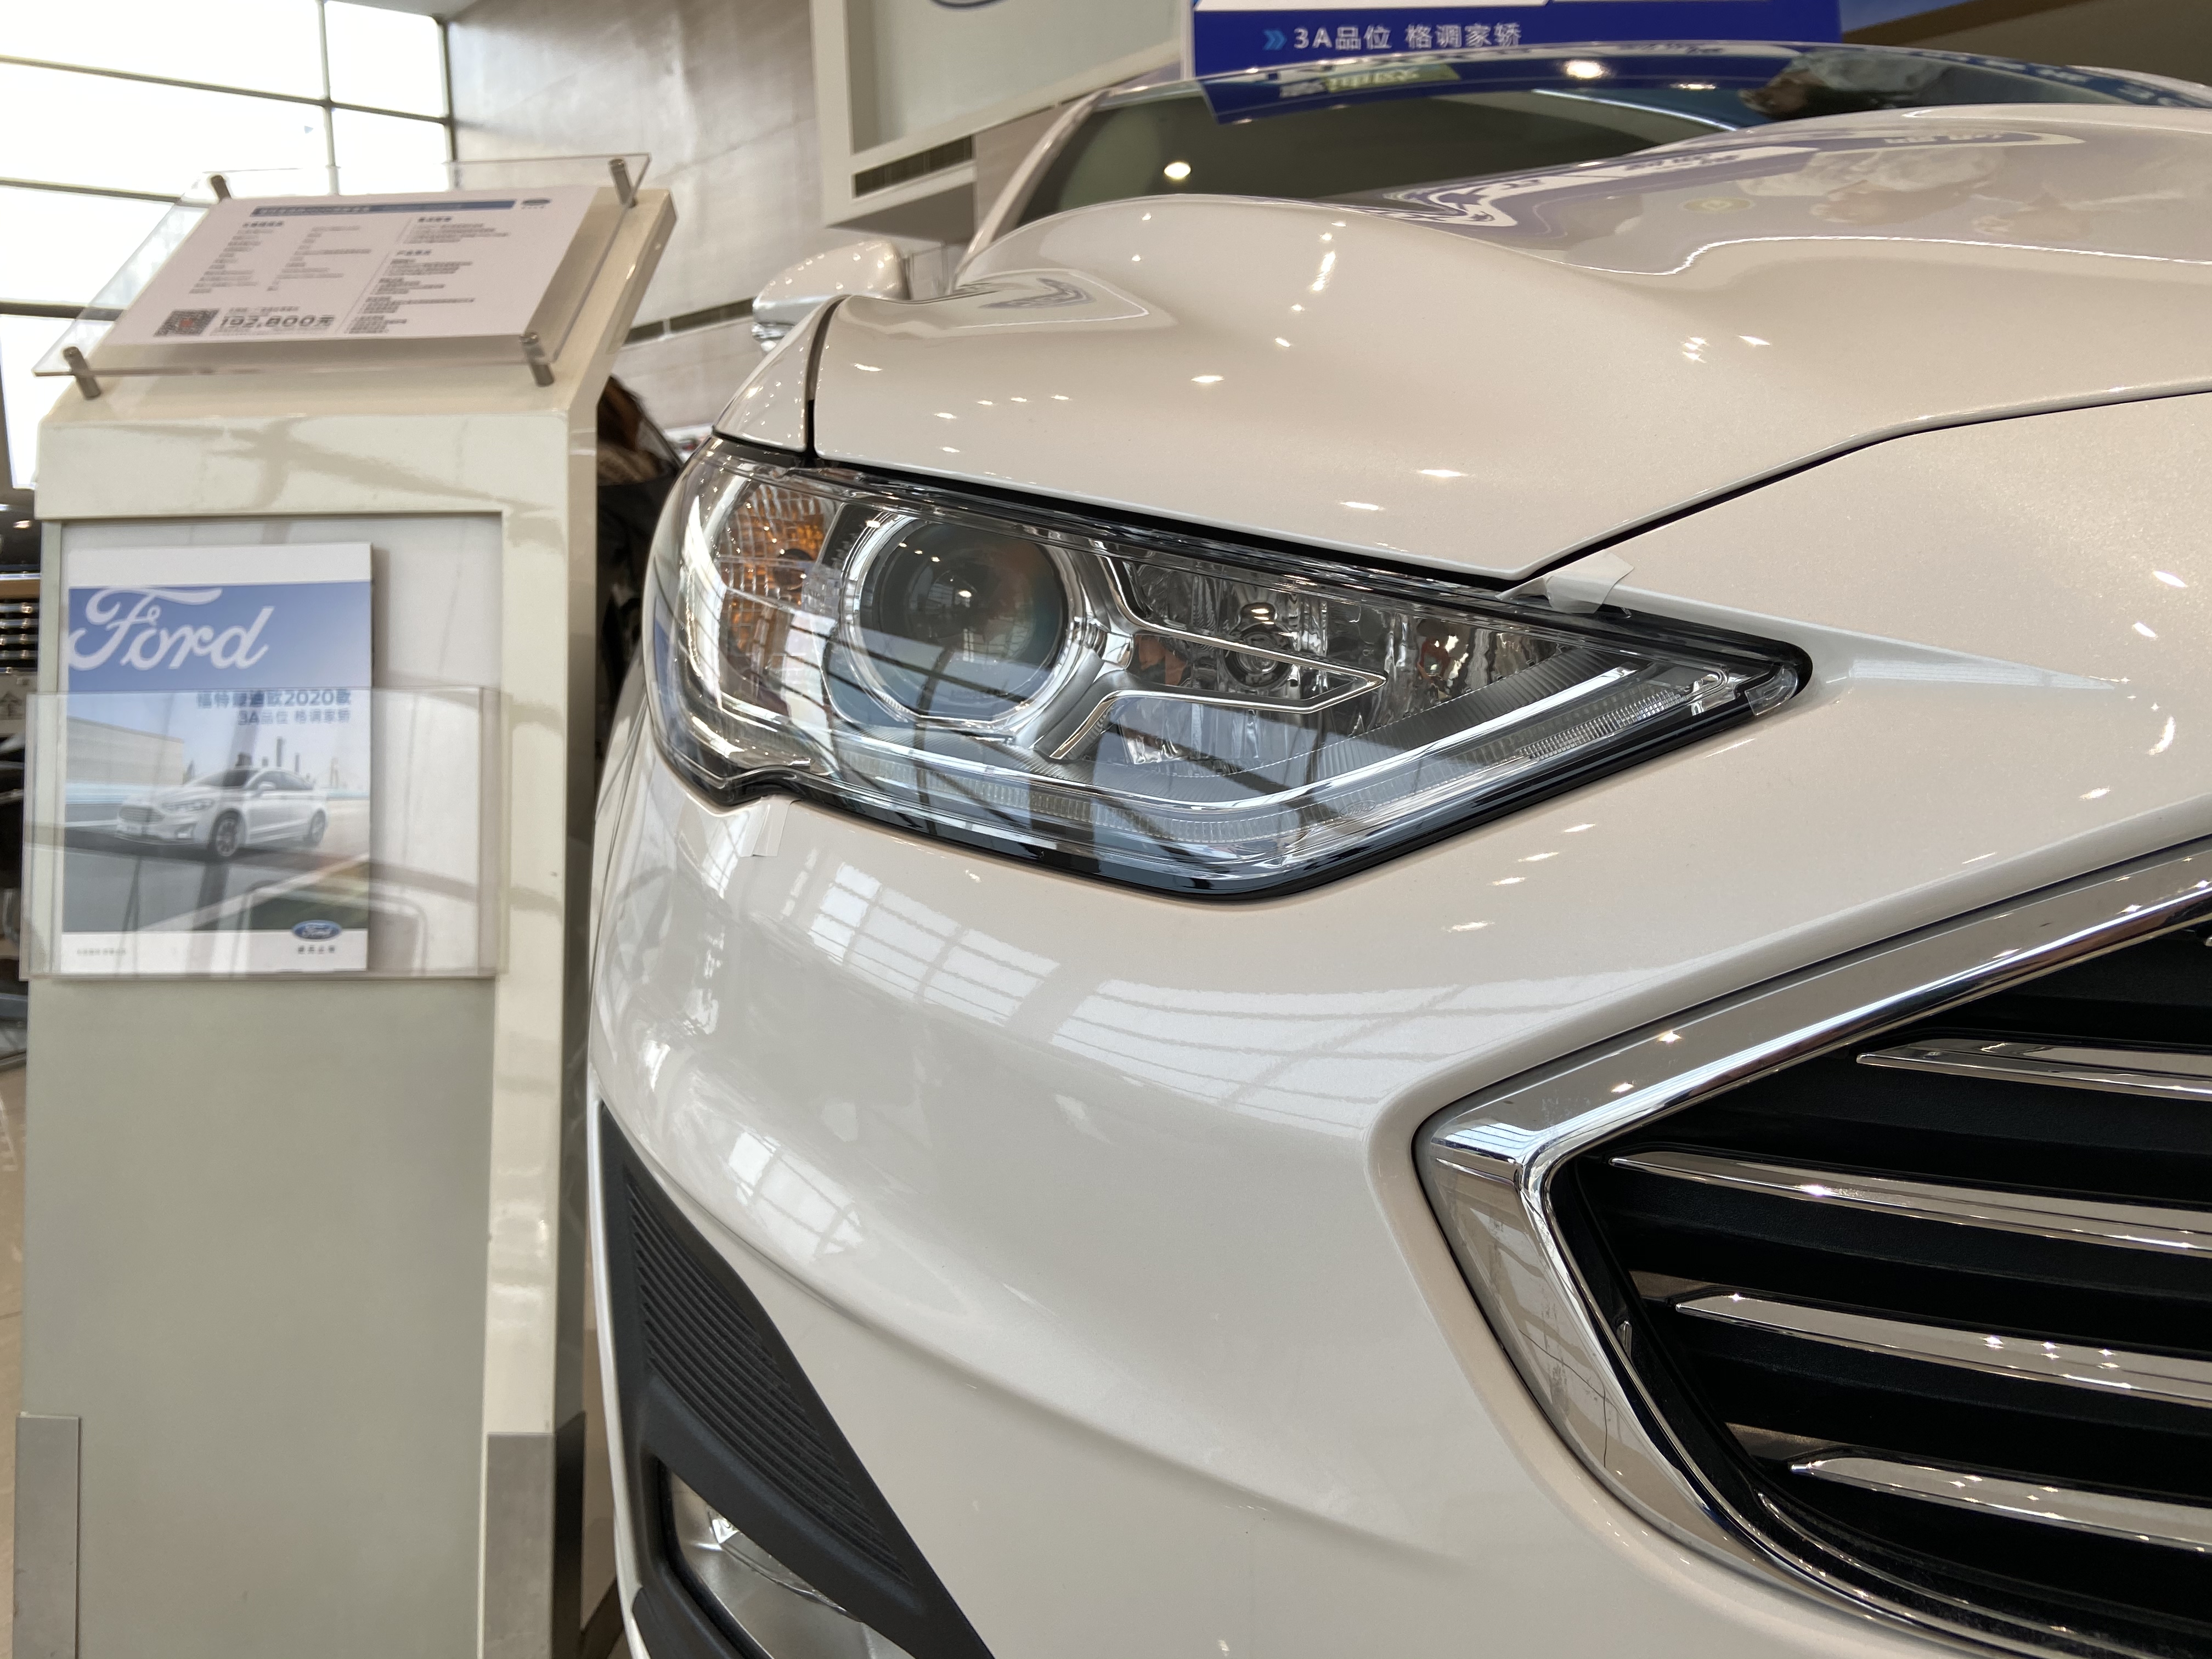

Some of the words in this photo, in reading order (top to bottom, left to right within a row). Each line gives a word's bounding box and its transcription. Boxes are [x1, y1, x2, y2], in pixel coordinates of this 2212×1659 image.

[1293, 25, 1392, 51] 3A品位
[1405, 22, 1522, 48] 格调家轿
[68, 588, 275, 671] Ford
